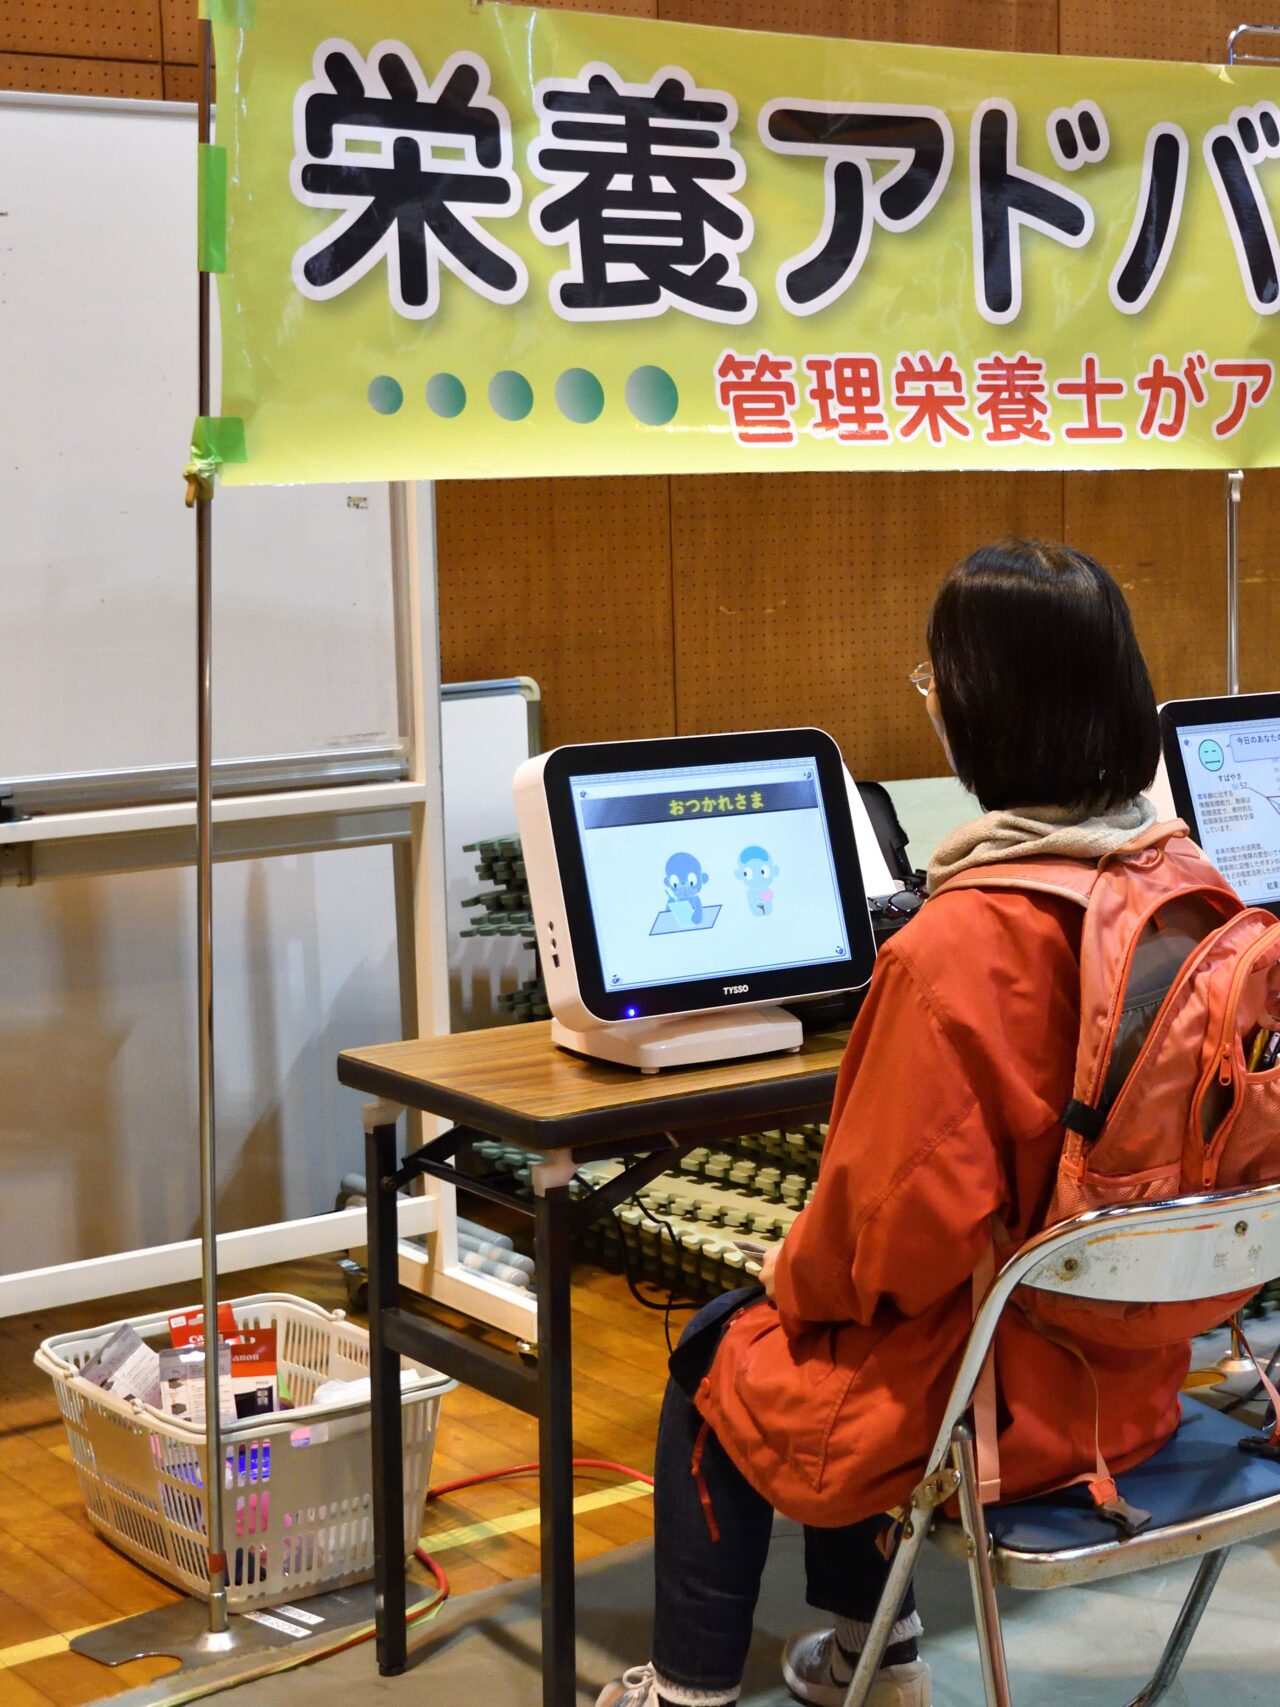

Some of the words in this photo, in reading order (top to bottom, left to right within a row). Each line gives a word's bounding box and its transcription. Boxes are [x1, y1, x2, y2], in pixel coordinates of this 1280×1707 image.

[1217, 773, 1242, 781] すばやさ
[668, 791, 764, 816] おつかれさま
[722, 984, 749, 995] TYSSO
[232, 1353, 260, 1362] anon
